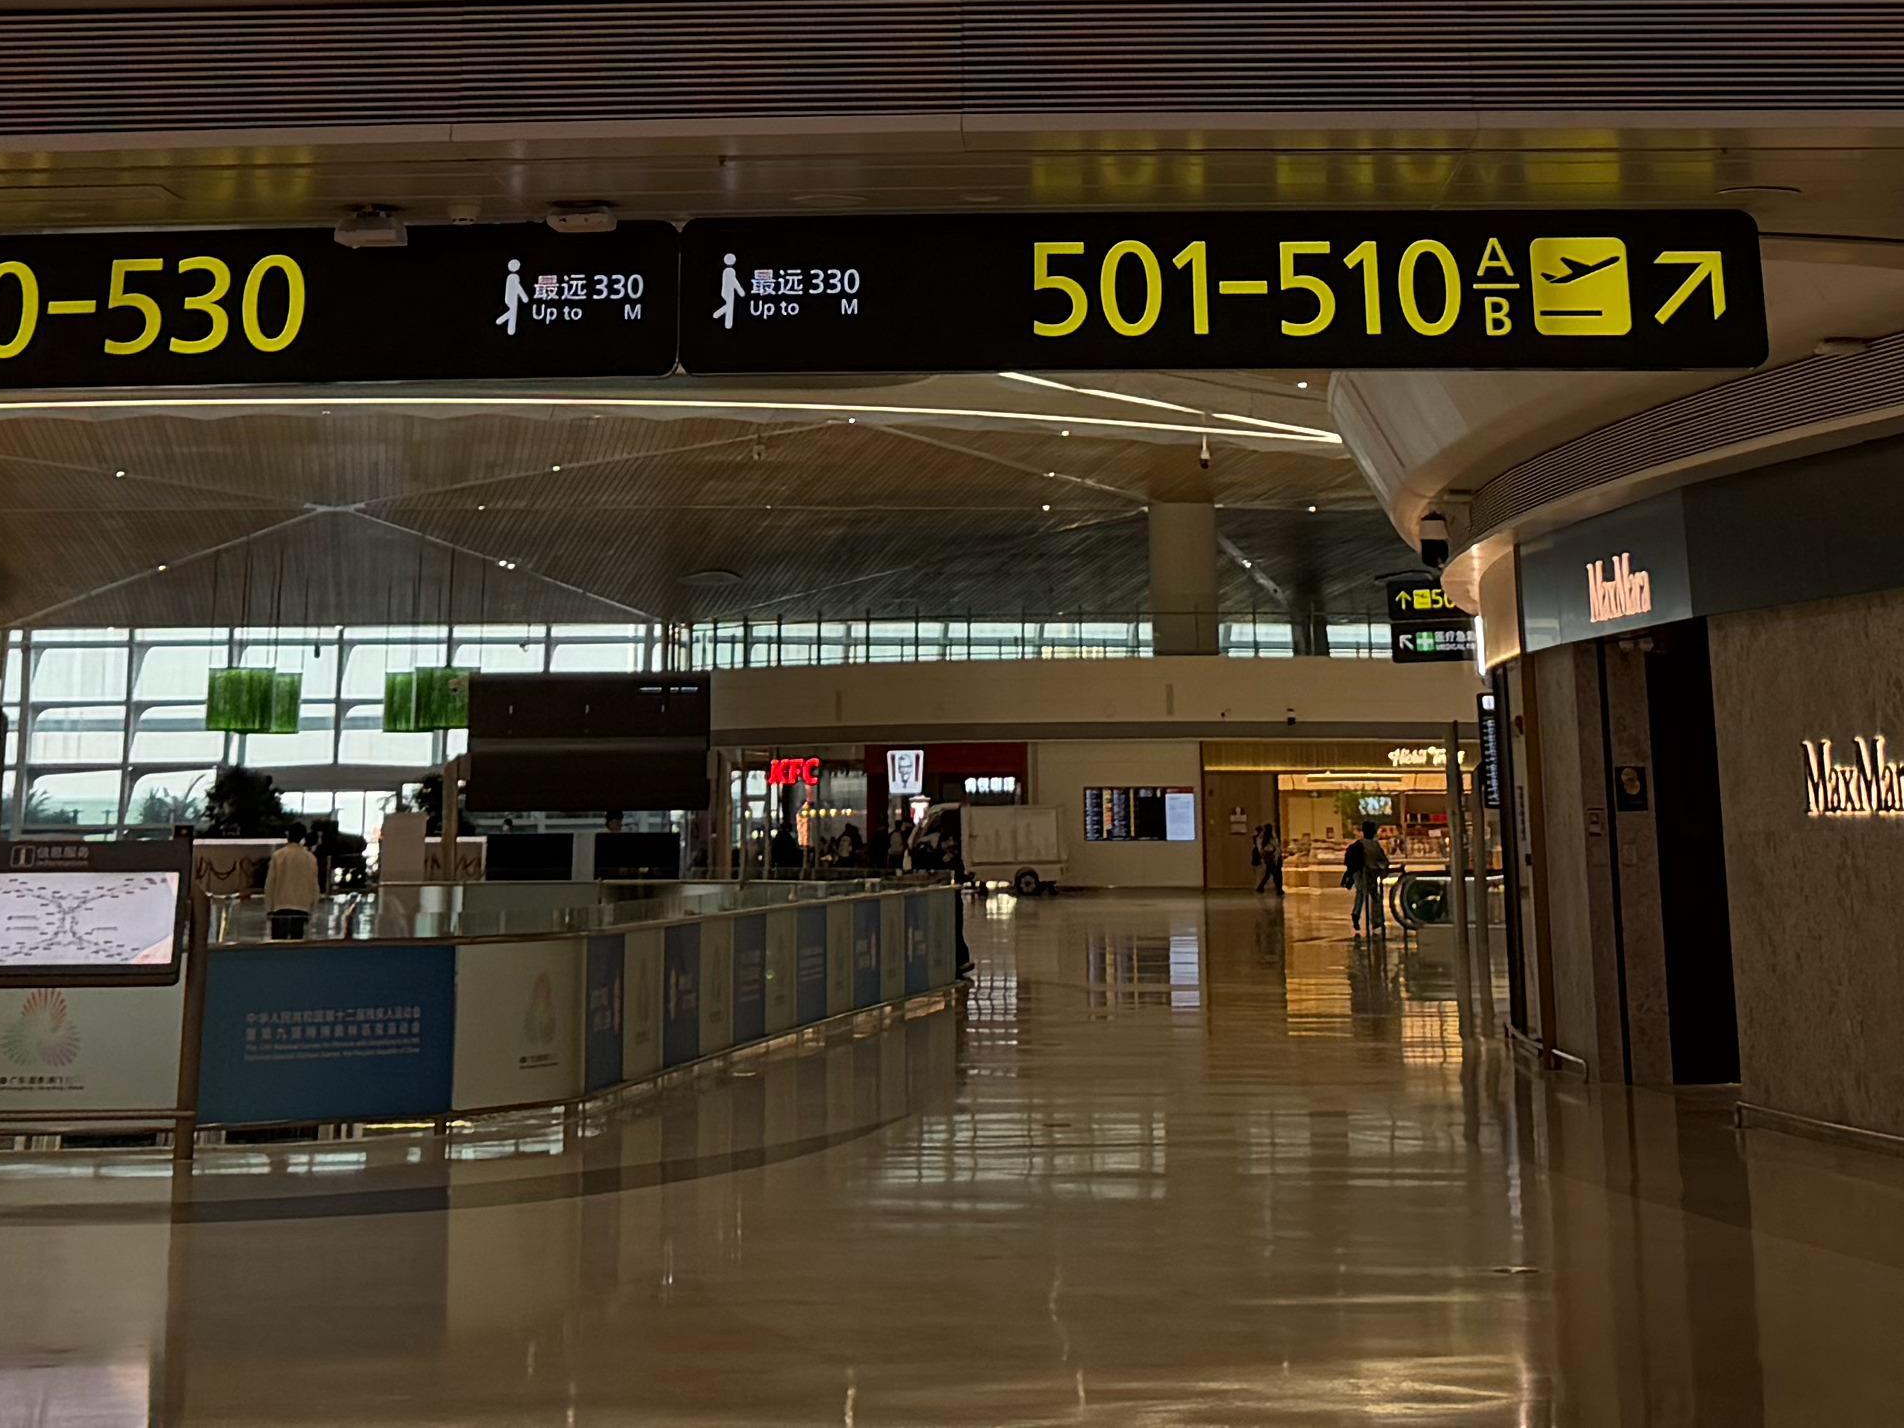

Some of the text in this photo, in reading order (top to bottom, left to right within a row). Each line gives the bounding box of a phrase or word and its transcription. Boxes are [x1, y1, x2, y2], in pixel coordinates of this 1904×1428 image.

[1474, 237, 1515, 277] A
[533, 273, 644, 301] 最远 330
[750, 268, 860, 296] 最远 330
[1033, 238, 1463, 338] 501-510
[531, 304, 642, 324] Up to M
[749, 298, 859, 319] Up to M
[1484, 296, 1513, 336] B
[768, 757, 820, 786] KFC
